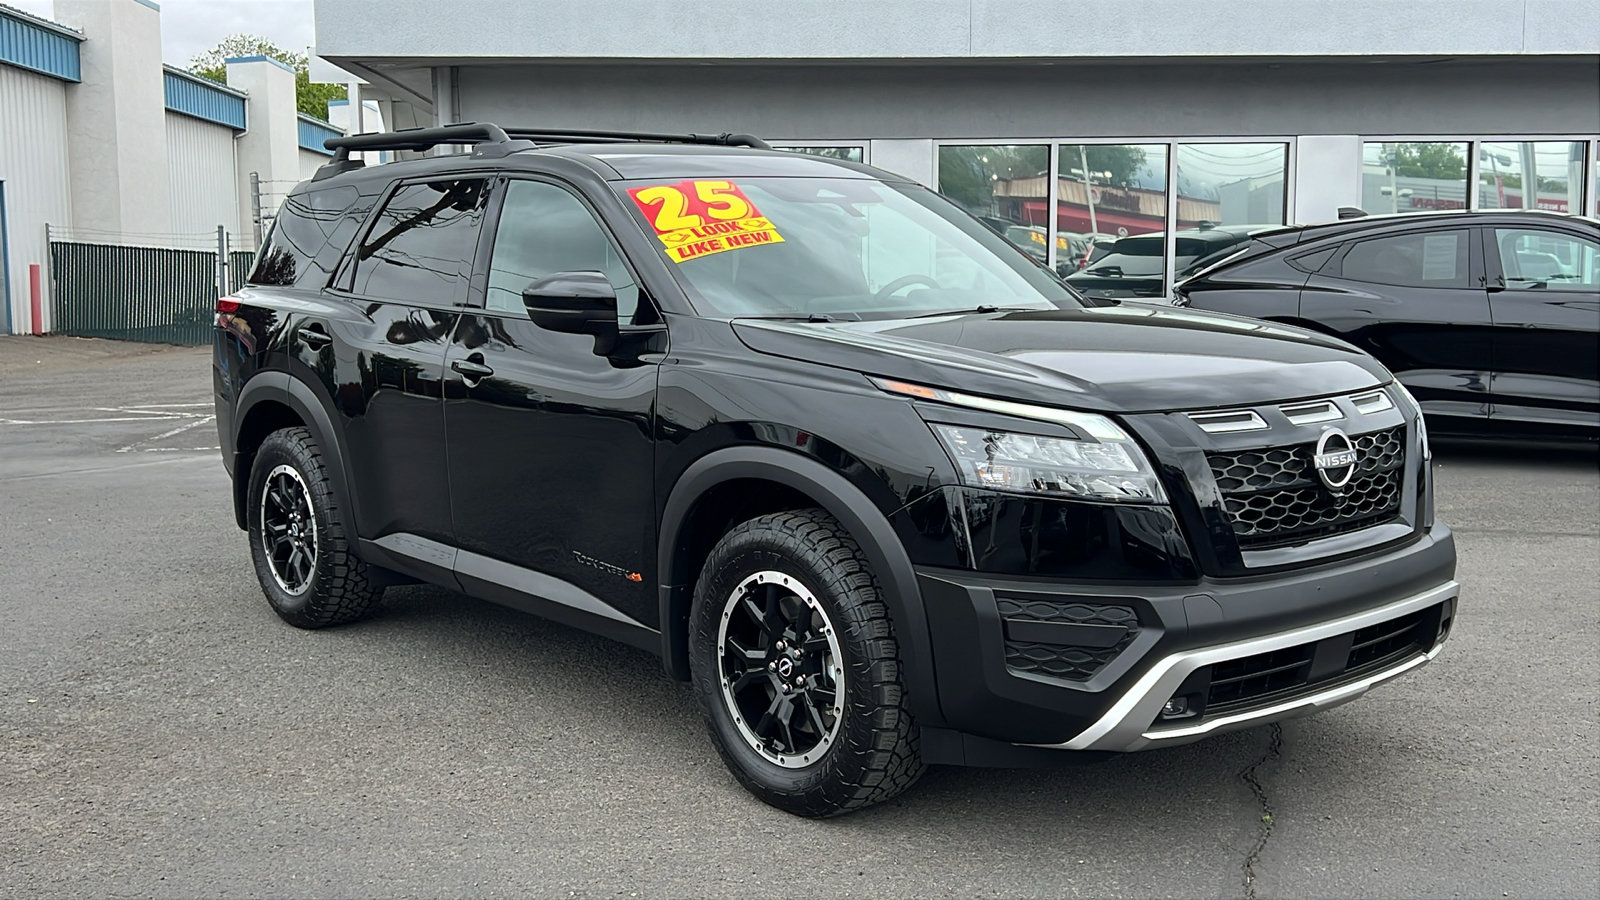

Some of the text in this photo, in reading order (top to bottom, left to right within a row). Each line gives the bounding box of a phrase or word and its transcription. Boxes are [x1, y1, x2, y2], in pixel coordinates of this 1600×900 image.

[635, 180, 752, 232] 25
[690, 220, 745, 239] LOOK
[676, 230, 772, 260] LIKE NEW
[1316, 453, 1358, 468] NISSAN
